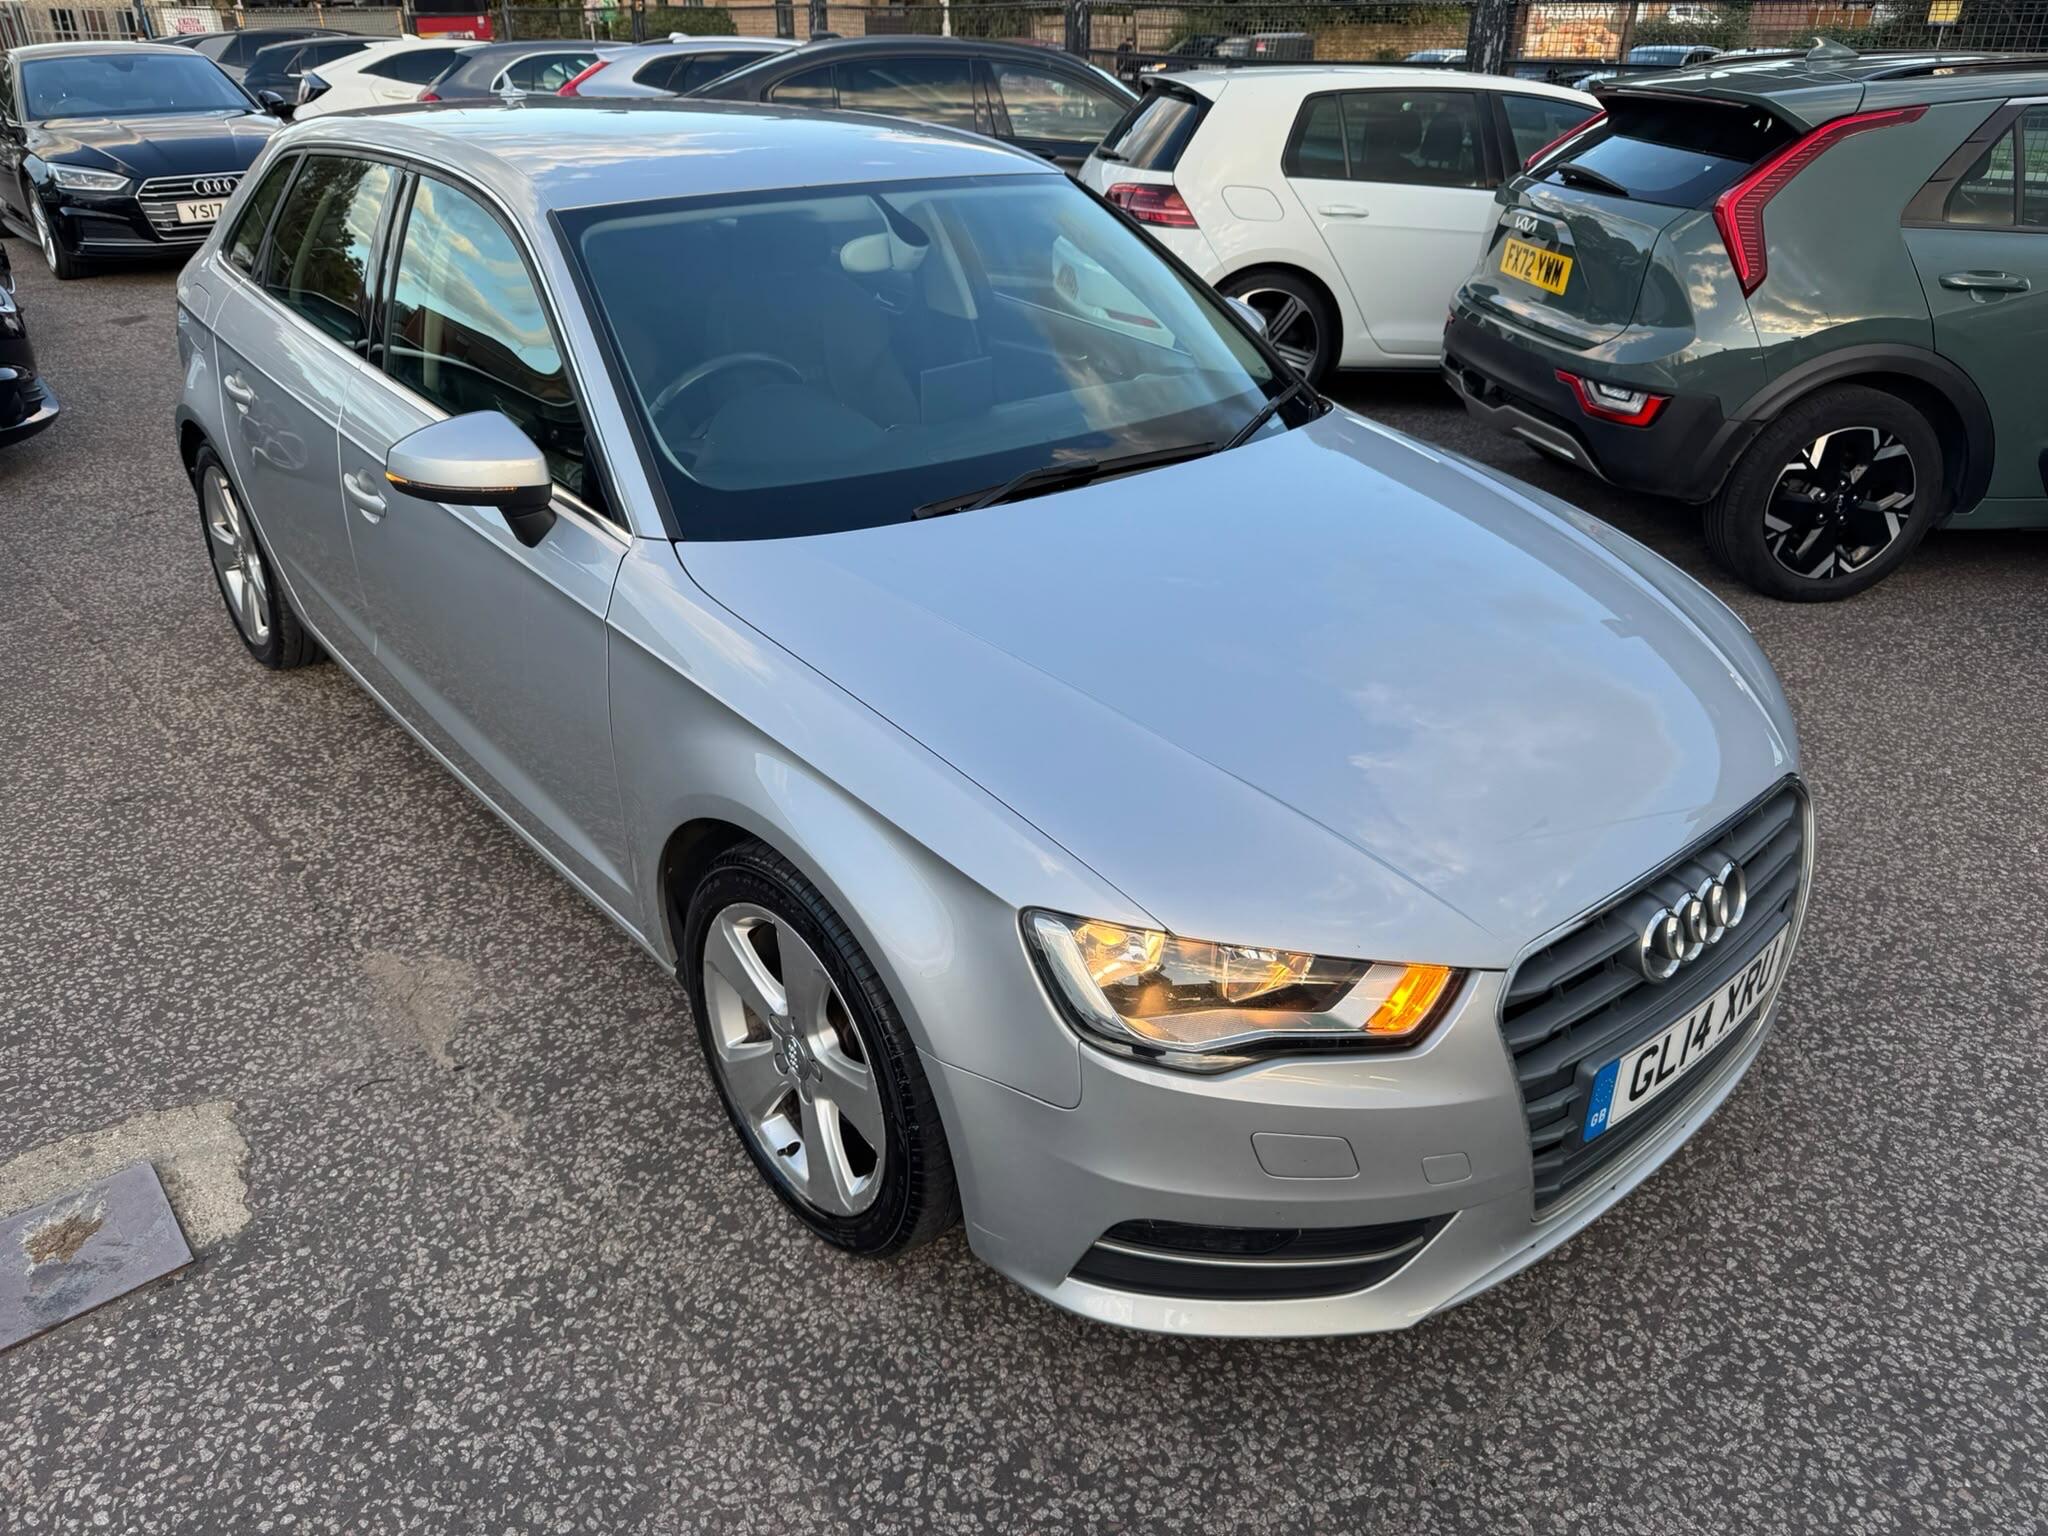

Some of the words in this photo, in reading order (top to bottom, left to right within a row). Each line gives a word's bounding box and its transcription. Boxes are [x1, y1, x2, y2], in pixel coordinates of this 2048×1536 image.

[1538, 5, 1617, 21] TAKEAWAY
[187, 203, 223, 219] YS17
[1505, 243, 1536, 277] FX72
[1537, 253, 1565, 288] YWM
[1629, 1000, 1715, 1102] GL14
[1718, 940, 1780, 1035] XRU
[1590, 1108, 1608, 1127] GB
